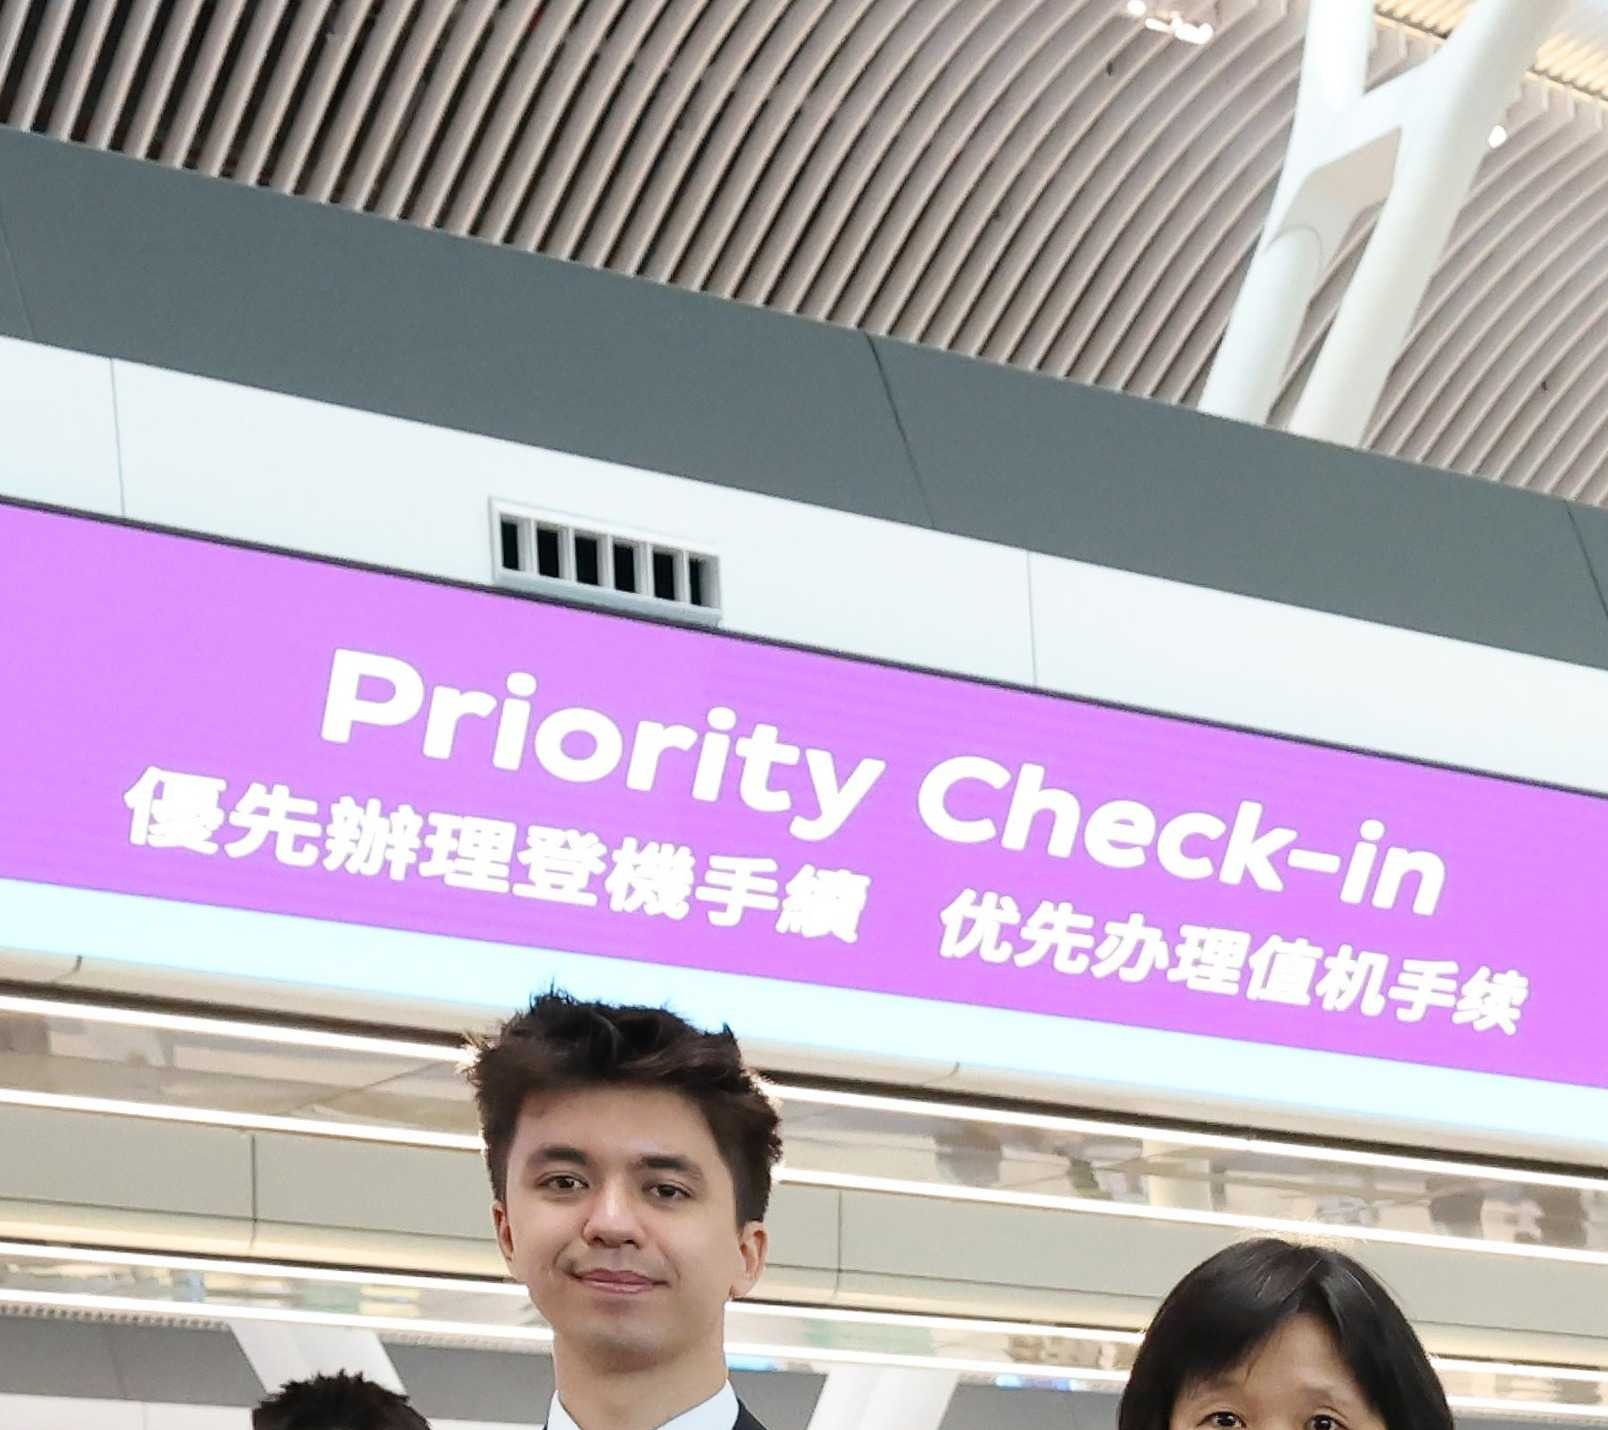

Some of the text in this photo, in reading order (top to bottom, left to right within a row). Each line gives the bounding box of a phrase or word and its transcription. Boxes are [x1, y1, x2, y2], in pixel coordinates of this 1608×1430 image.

[124, 767, 1528, 1035] 優先辦理登機手續 优先办理值机手续
[322, 649, 1444, 915] Priority Check-in
